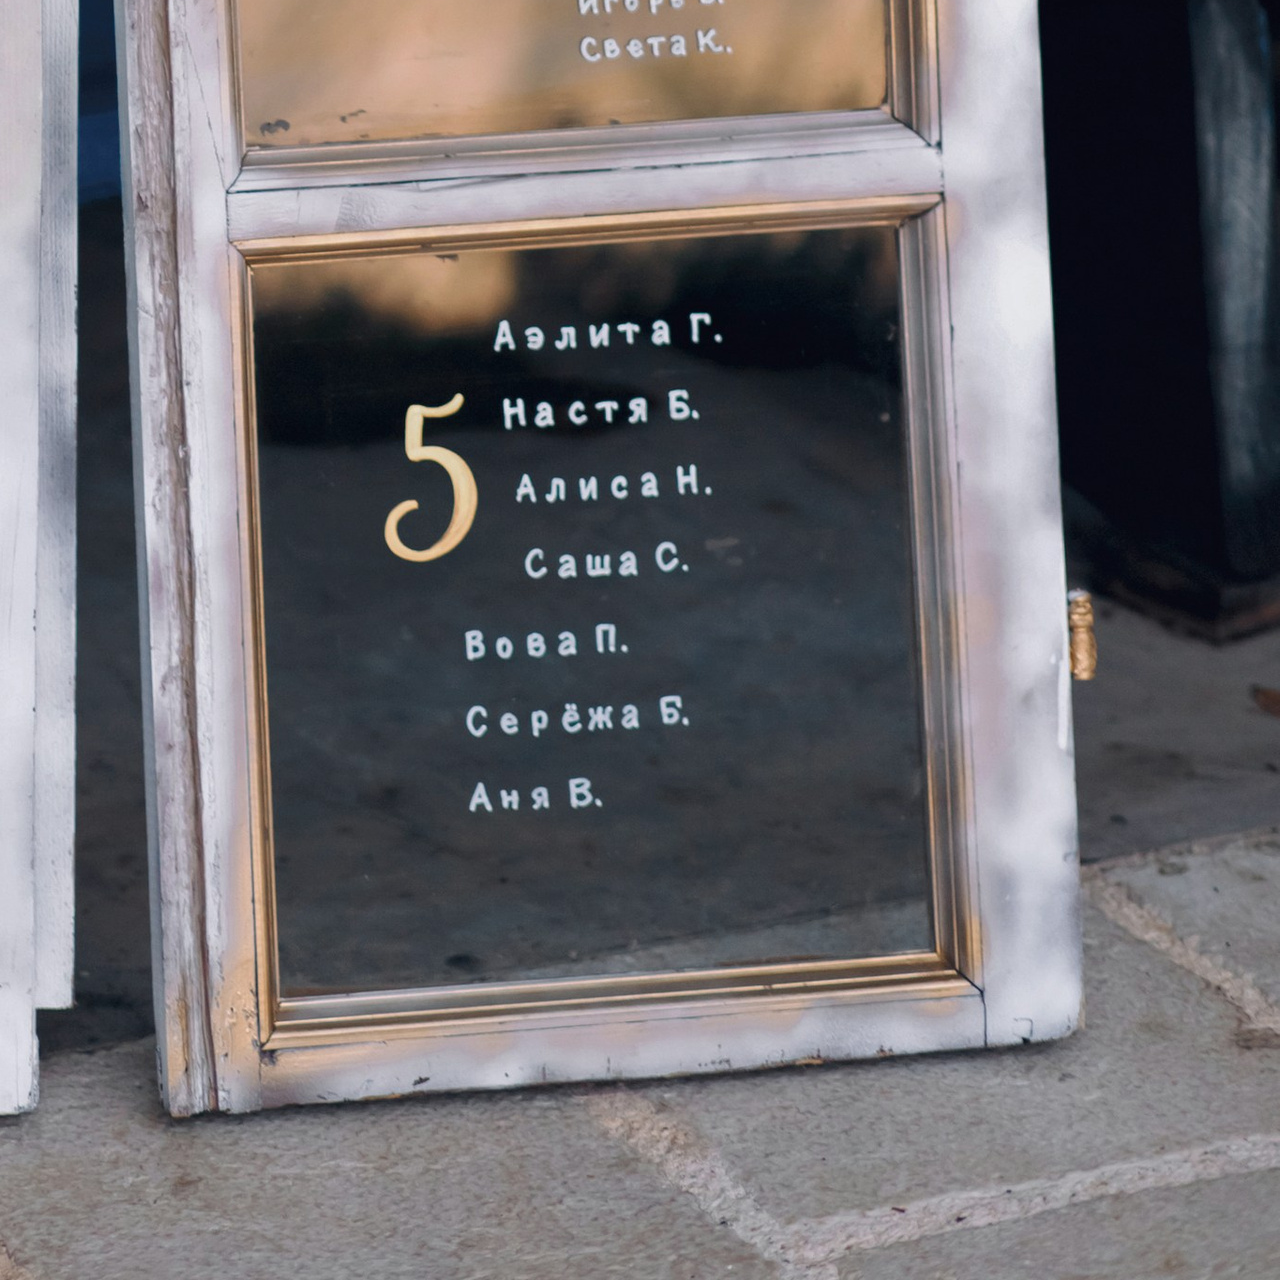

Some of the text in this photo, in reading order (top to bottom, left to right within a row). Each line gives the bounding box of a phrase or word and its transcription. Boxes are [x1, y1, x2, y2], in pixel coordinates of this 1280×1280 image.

[580, 30, 733, 63] Света К.
[493, 313, 723, 352] Аэлита Г.
[503, 390, 700, 429] Настя Б.
[384, 393, 478, 562] 5
[516, 465, 713, 504] Алиса Н.
[525, 542, 690, 579] Саша С.
[466, 624, 629, 661] Вова П.
[467, 696, 690, 738] Серёжа Б.
[469, 777, 603, 812] Аня В.
